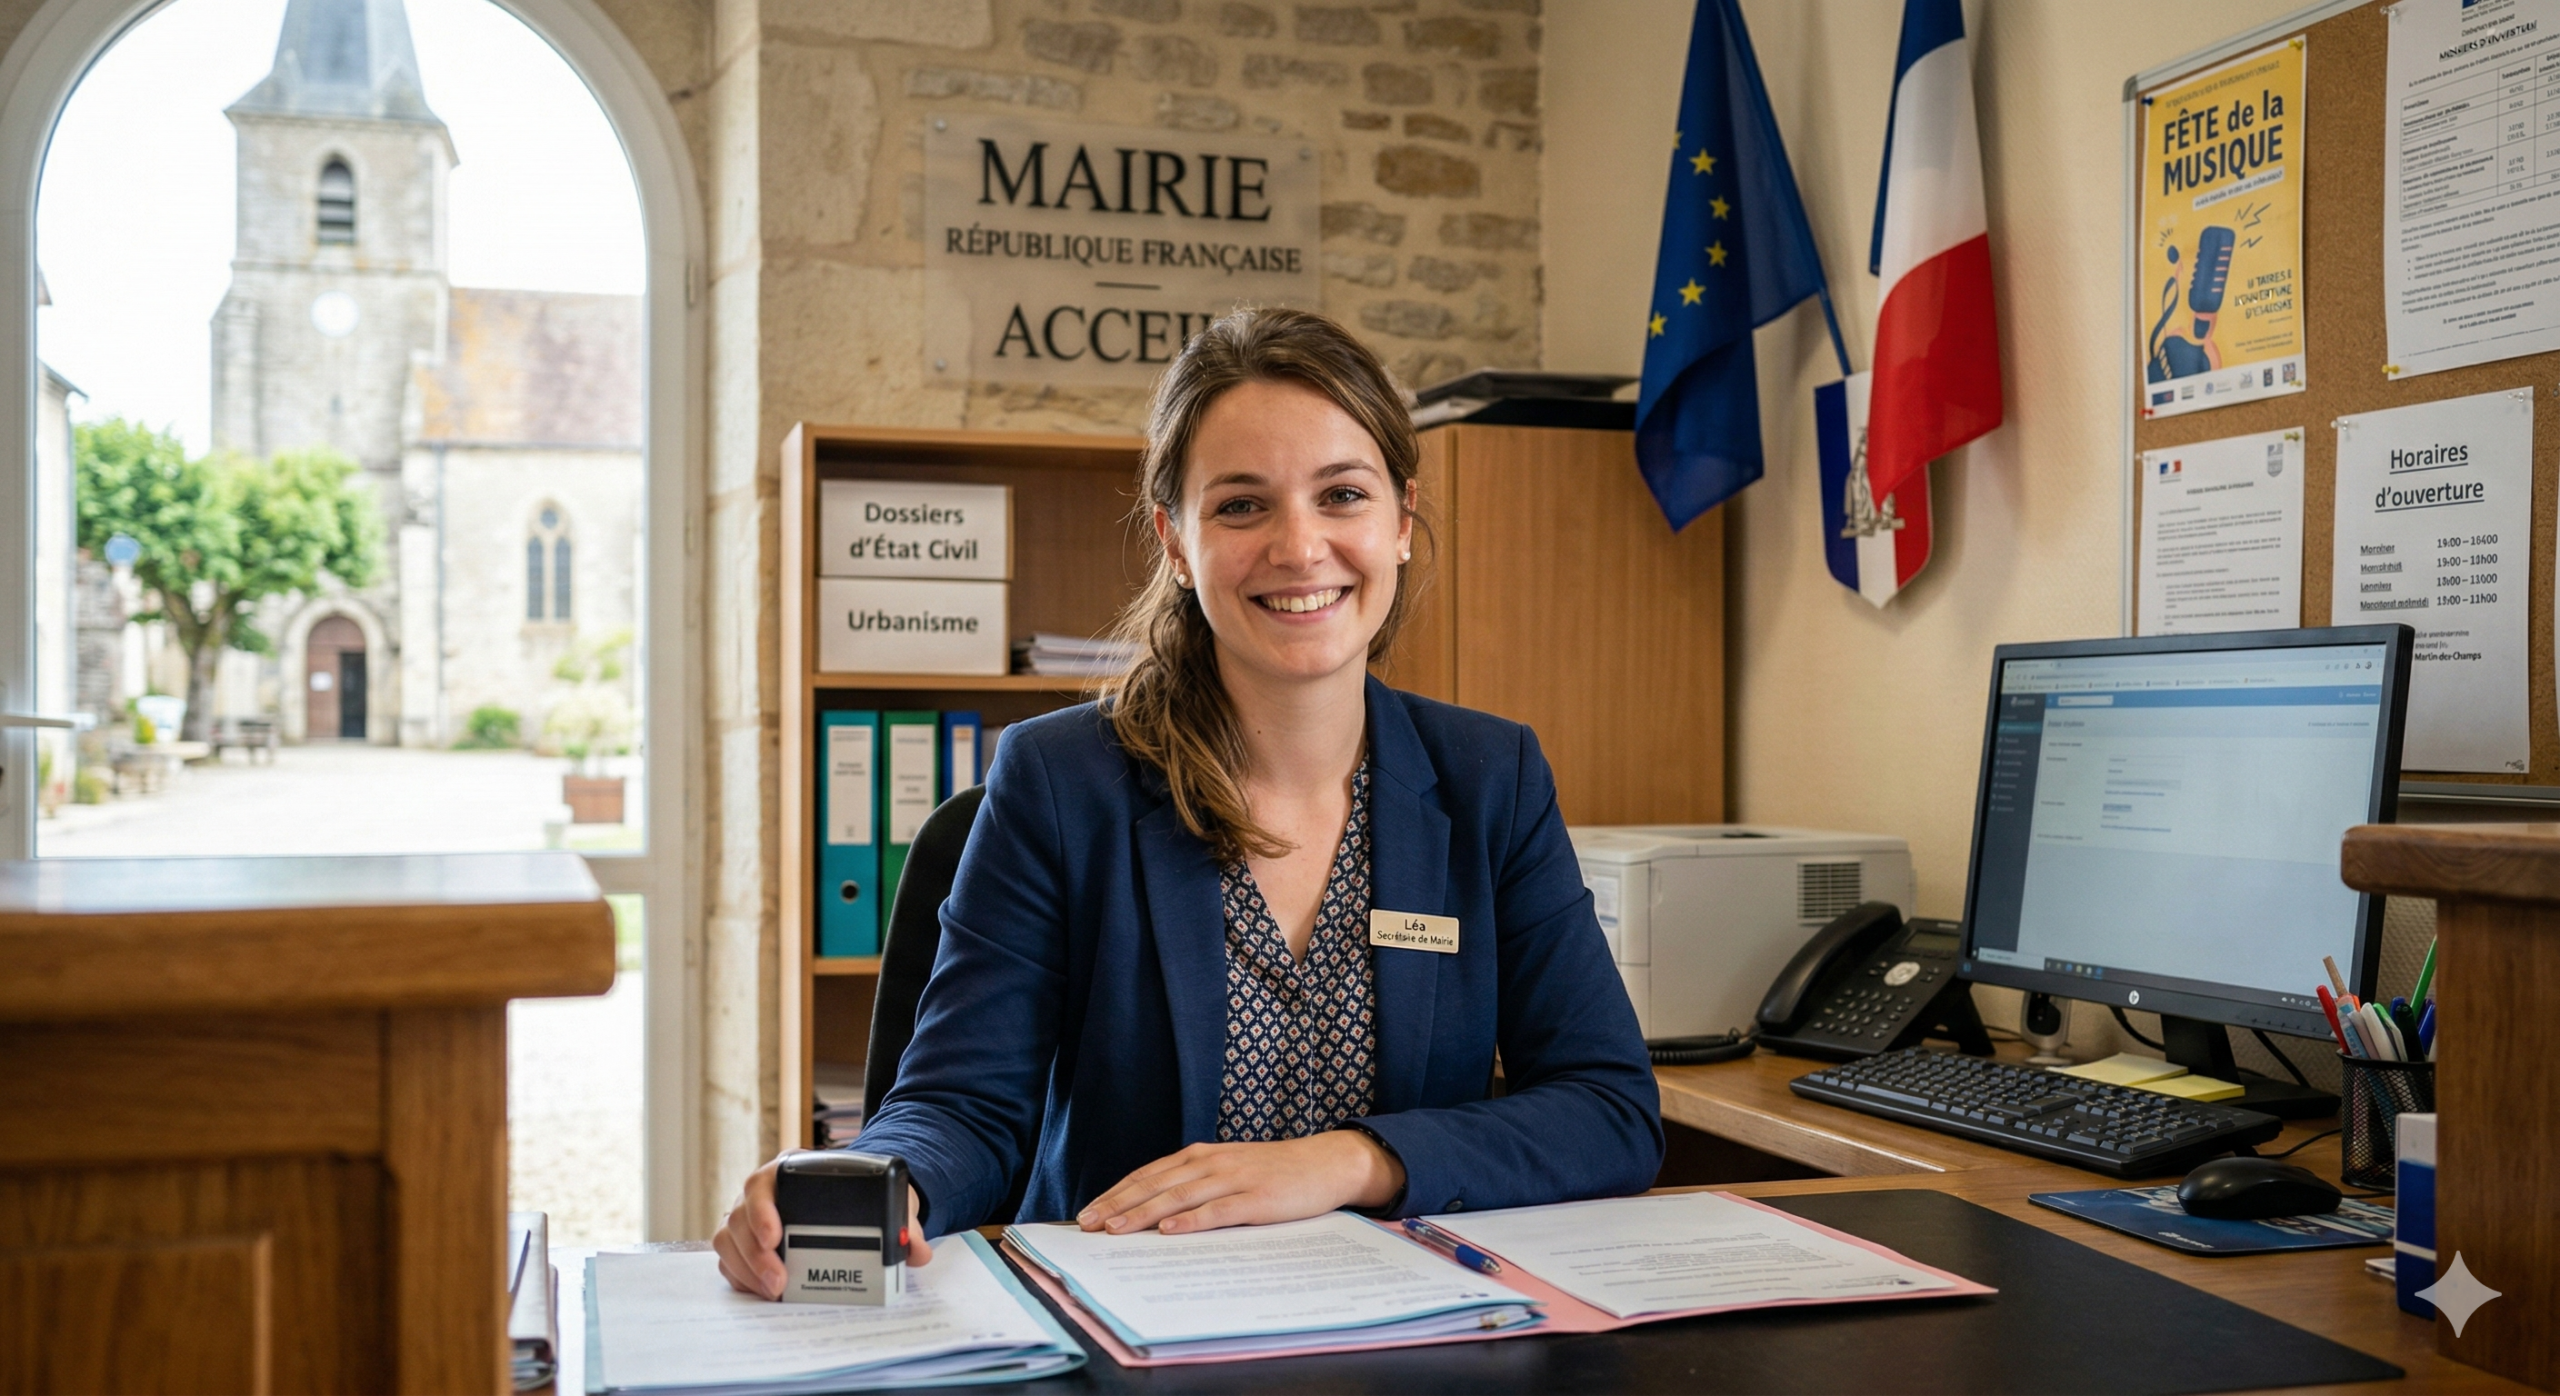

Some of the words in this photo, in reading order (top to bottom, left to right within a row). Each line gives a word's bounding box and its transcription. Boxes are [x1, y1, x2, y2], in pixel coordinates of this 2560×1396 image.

[2164, 105, 2219, 154] FÊTE
[2227, 100, 2254, 132] de
[2263, 89, 2284, 121] la
[2164, 124, 2283, 196] MUSIQUE
[977, 138, 1272, 222] MAIRIE
[945, 222, 1133, 266] RÉPUBLIQUE
[1142, 239, 1302, 275] FRANÇAISE
[993, 303, 1213, 365] ACCEI
[2391, 443, 2468, 470] Horaires
[2375, 482, 2484, 508] d’ouverture
[865, 502, 964, 525] Dossiers
[849, 534, 920, 560] d’État
[929, 540, 978, 560] Civil
[848, 610, 978, 634] Urbanisme
[1405, 919, 1426, 931] Léa
[1418, 934, 1428, 944] de
[1430, 935, 1453, 946] Mairie
[808, 1269, 863, 1283] MAIRIE
